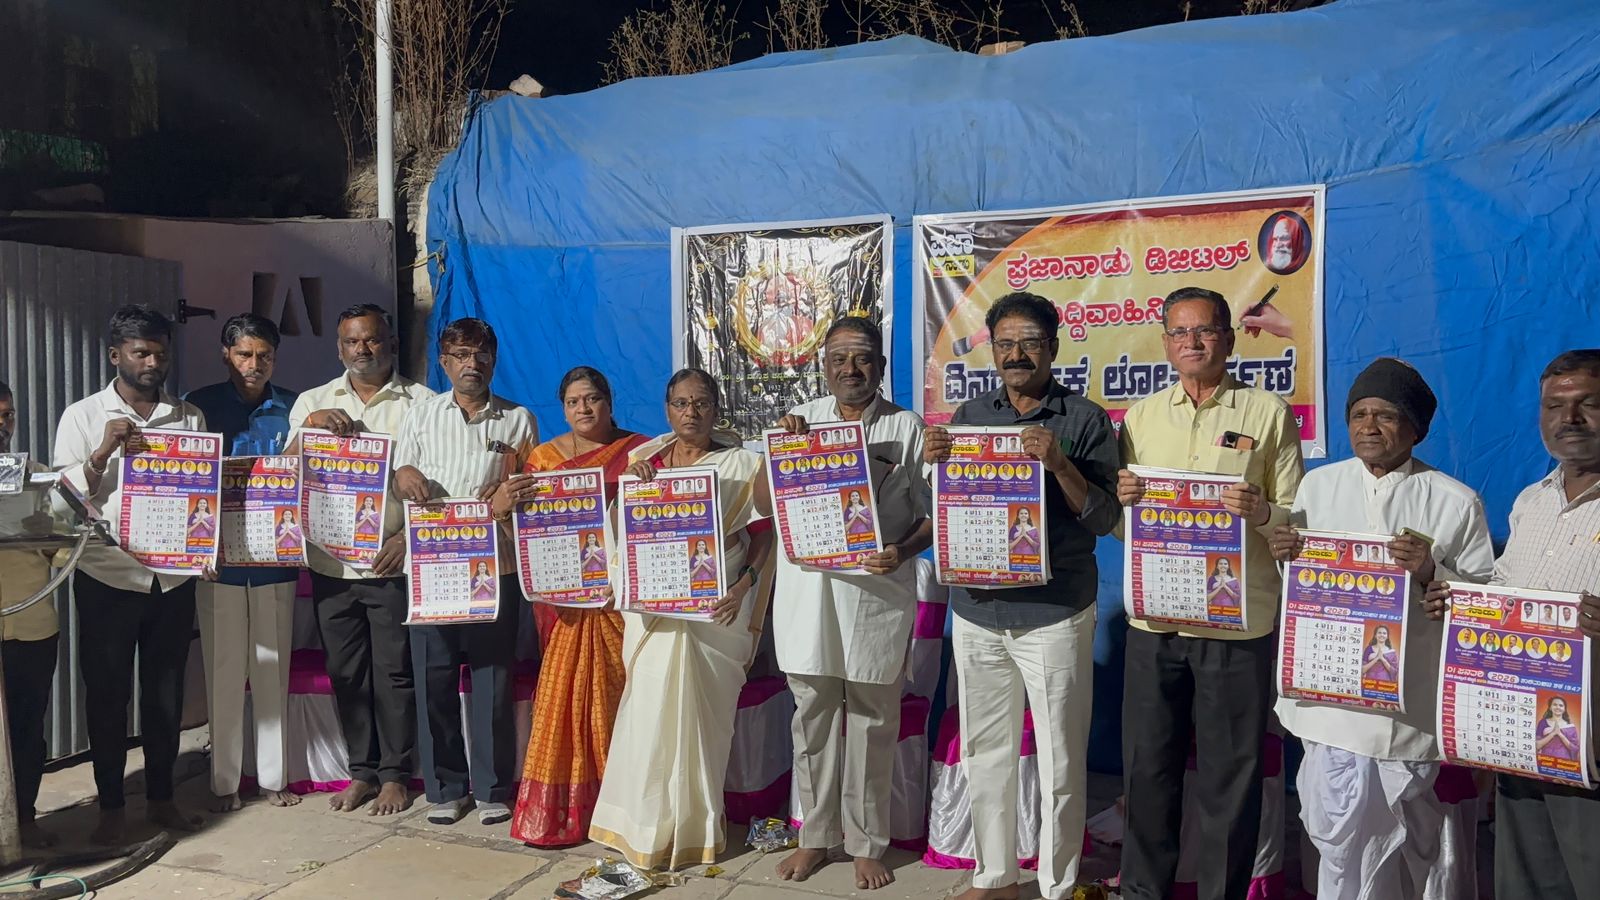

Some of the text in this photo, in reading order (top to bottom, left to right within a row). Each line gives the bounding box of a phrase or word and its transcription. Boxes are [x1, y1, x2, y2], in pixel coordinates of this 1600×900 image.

[1007, 240, 1250, 288] ಪ್ರಜಾನಾಡು ಡಿಜಿಟಲ್
[1453, 592, 1502, 608] ಪ್ರಜಾ
[1492, 673, 1516, 682] 2026
[1506, 751, 1515, 759] 23
